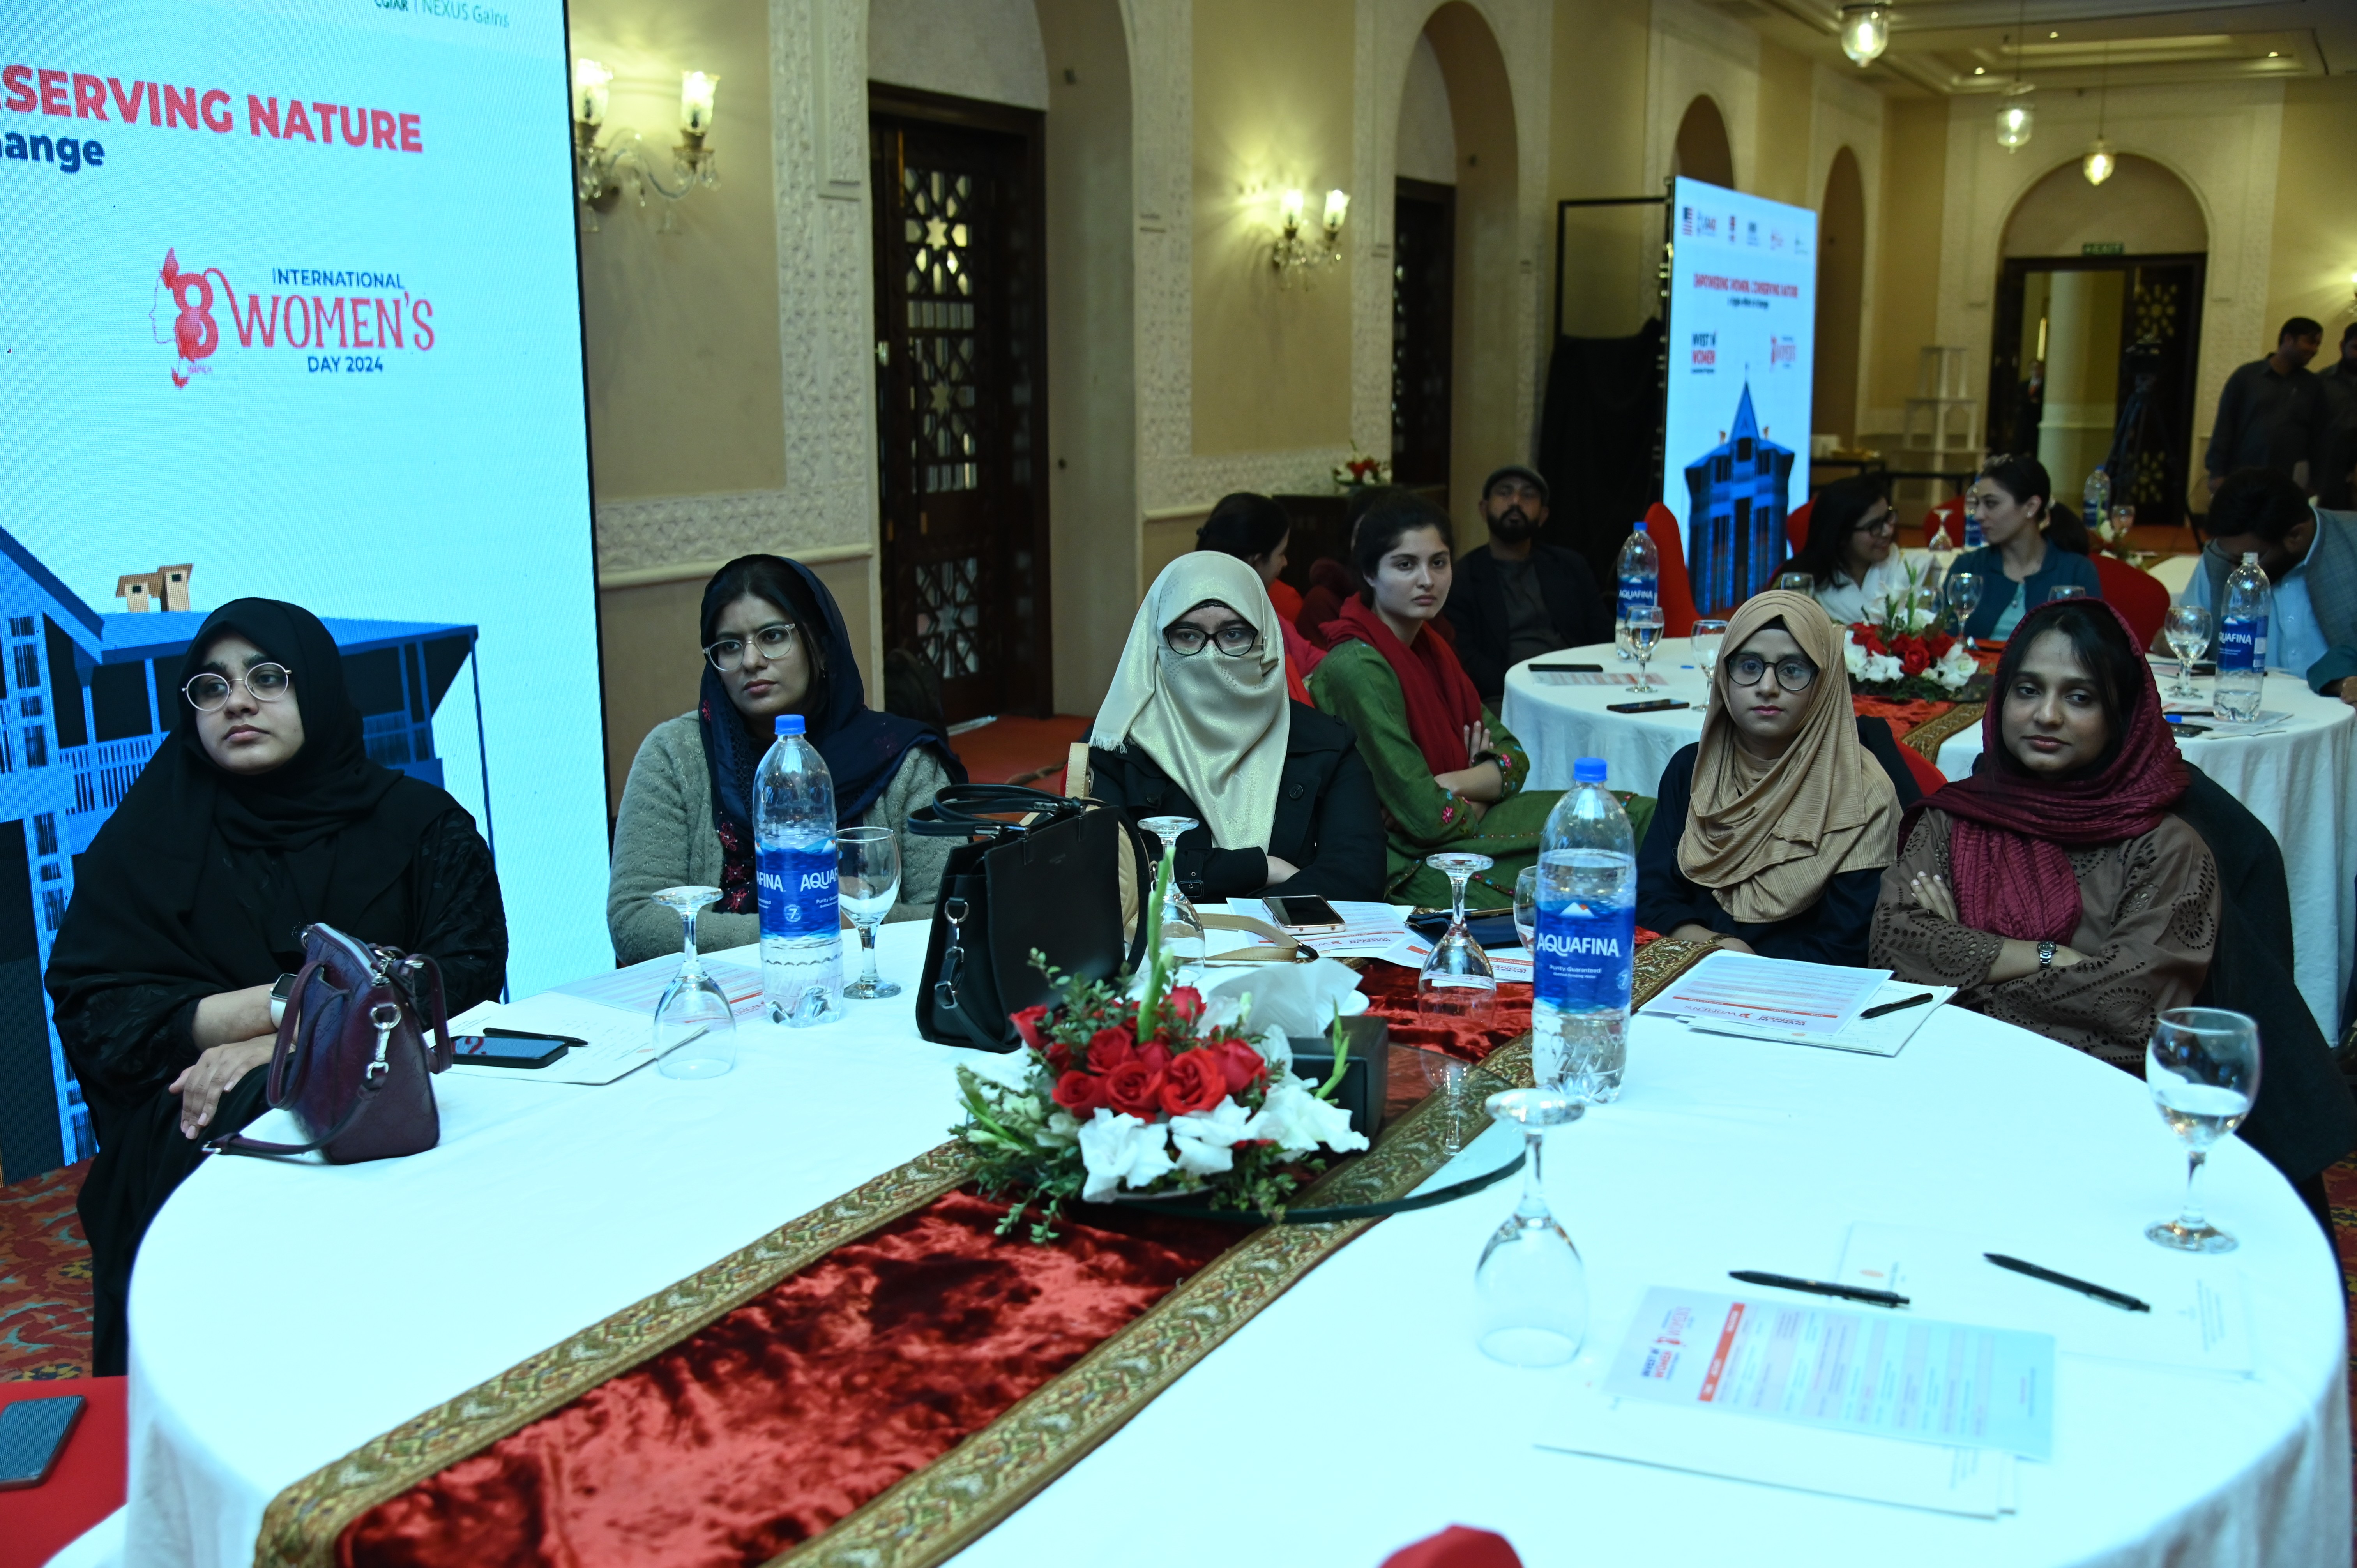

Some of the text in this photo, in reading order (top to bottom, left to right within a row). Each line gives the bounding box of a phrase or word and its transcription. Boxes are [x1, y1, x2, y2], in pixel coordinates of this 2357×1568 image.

[423, 0, 469, 21] NEXUS
[472, 5, 509, 28] Gains
[2, 63, 423, 153] SERVING NATURE
[0, 131, 105, 174] ange
[272, 268, 406, 289] INTERNATIONAL
[224, 289, 436, 351] WOMEN'S
[307, 356, 384, 373] DAY 2024
[1618, 589, 1653, 600] AQUAFINA
[2219, 631, 2252, 645] QUAFINA
[757, 871, 784, 892] AFINA
[800, 867, 839, 892] AQUAF
[789, 908, 797, 920] 7
[1537, 932, 1620, 957] AQUAFINA
